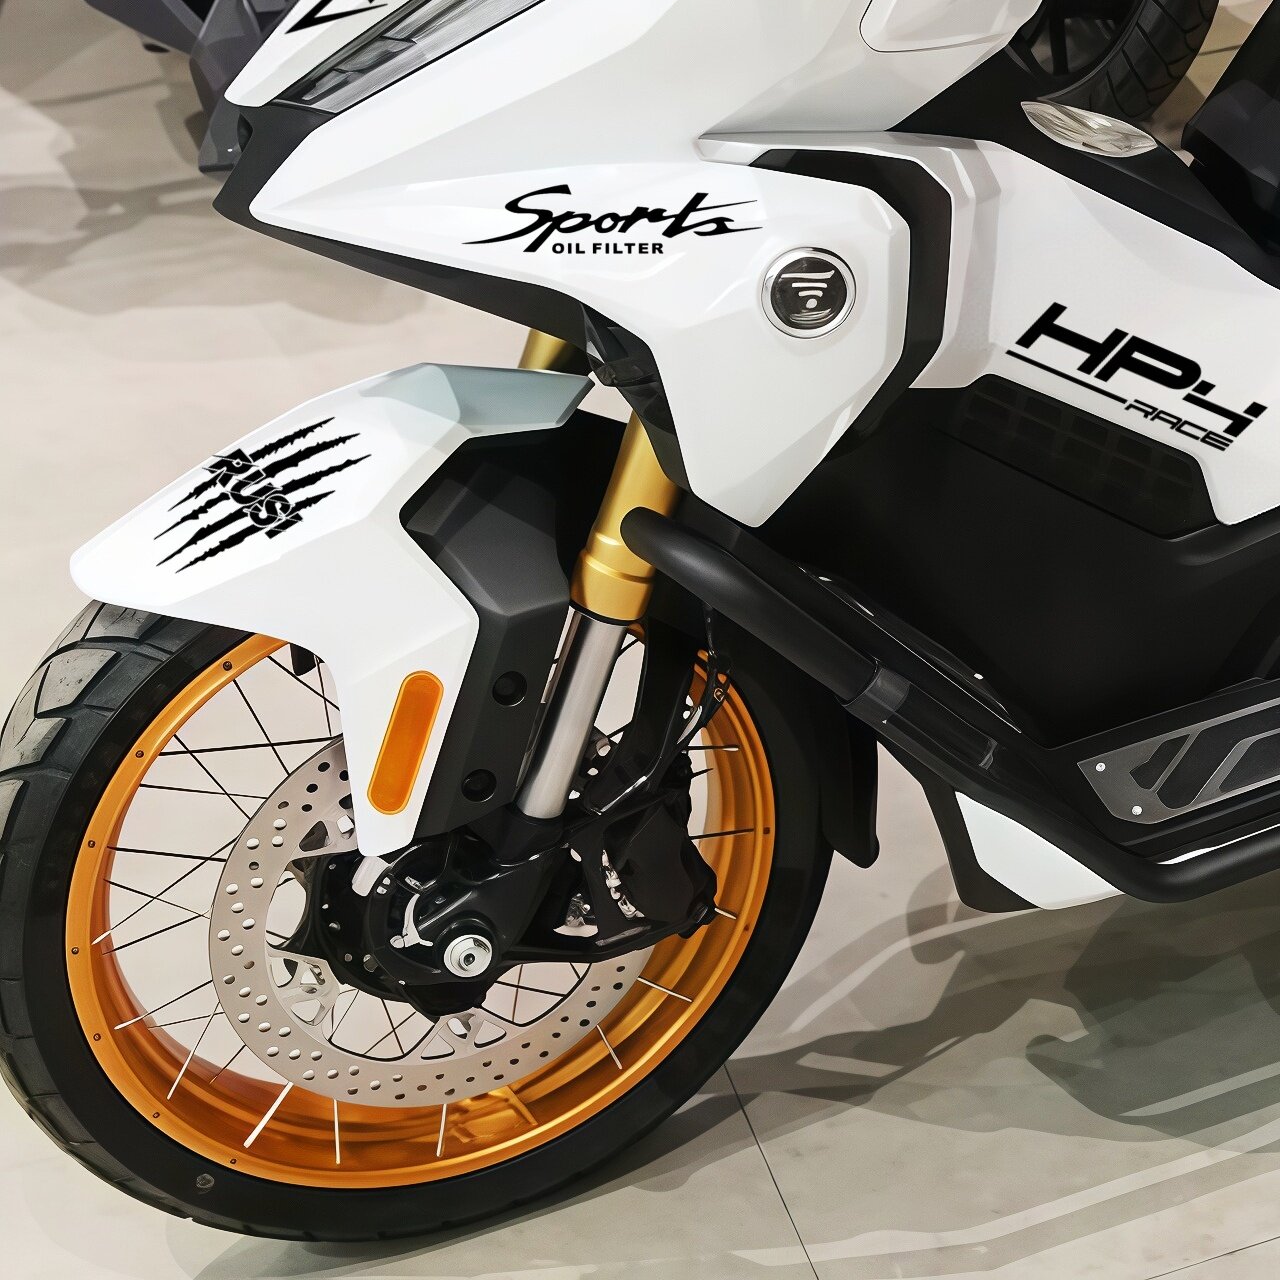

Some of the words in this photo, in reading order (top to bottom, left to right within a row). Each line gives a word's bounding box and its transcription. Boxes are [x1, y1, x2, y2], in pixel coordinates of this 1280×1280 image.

[460, 183, 764, 253] Sports
[551, 242, 586, 255] OIL
[592, 242, 664, 255] FILTER
[1015, 301, 1268, 438] HP4
[1124, 398, 1234, 452] RACE
